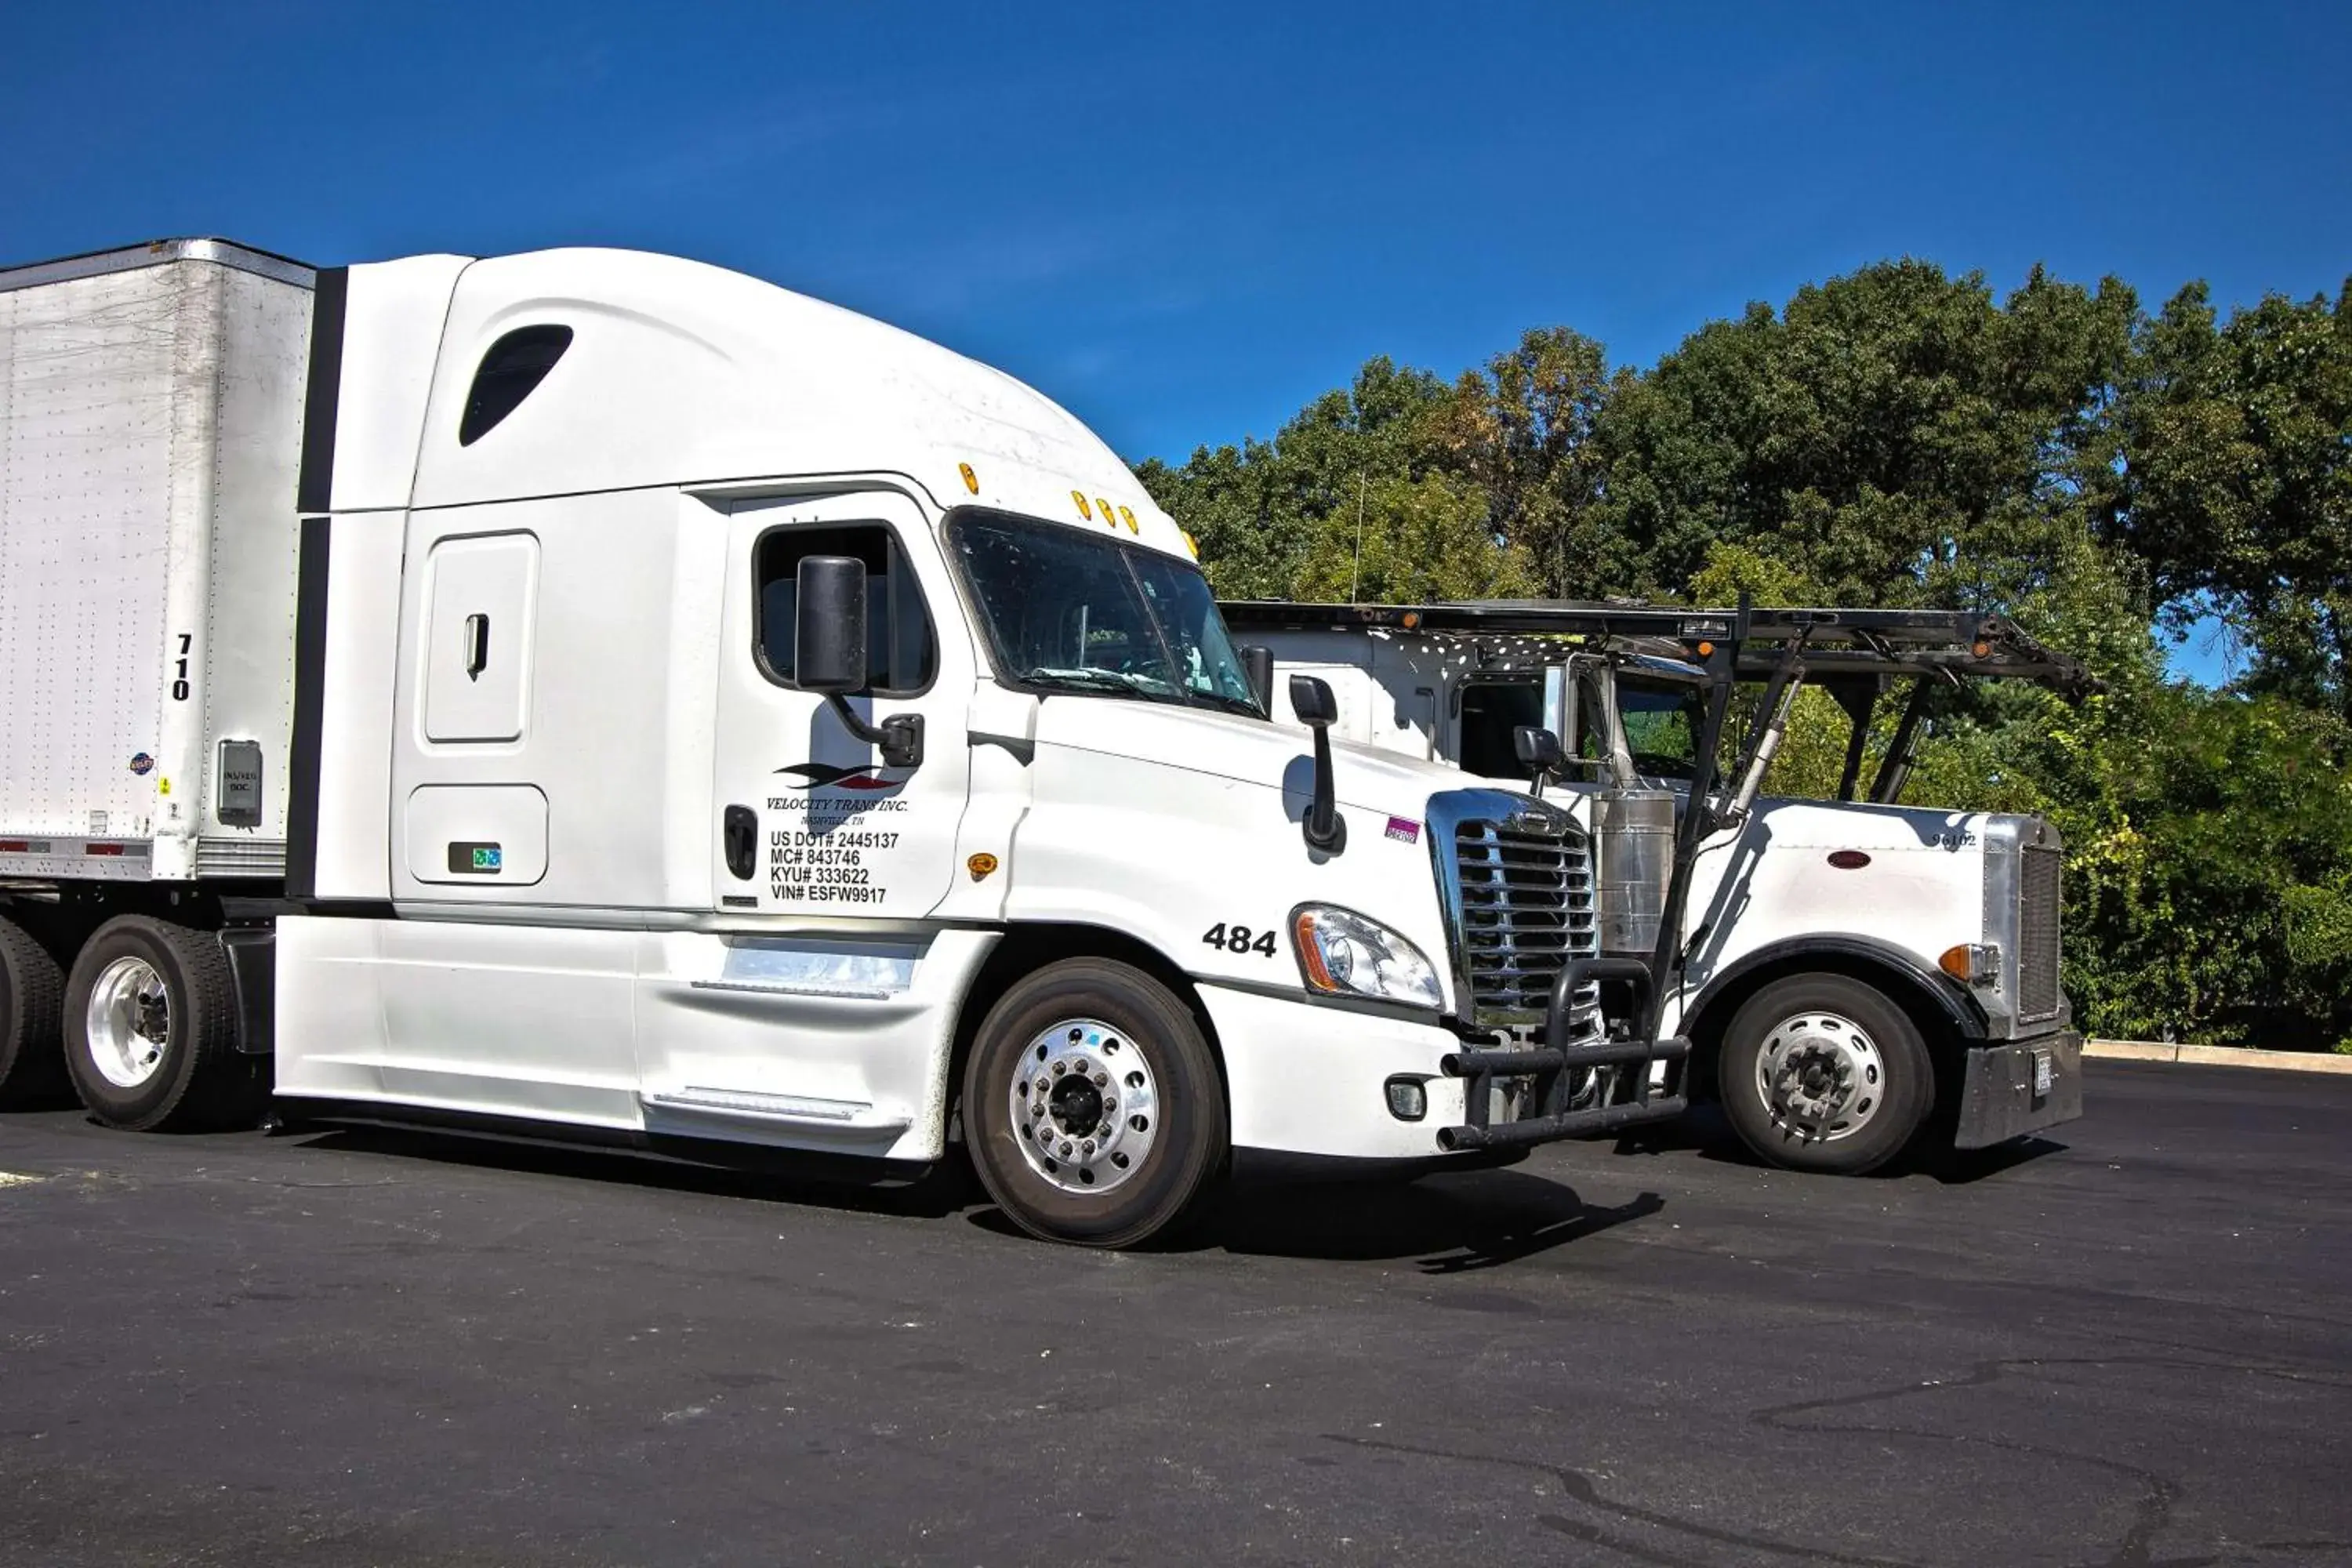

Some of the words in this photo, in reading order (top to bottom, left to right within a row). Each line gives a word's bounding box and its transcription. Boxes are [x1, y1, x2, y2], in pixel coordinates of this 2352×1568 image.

[172, 633, 191, 701] 710
[767, 797, 832, 810] VELOCITY
[833, 799, 877, 811] TRANS
[878, 800, 908, 811] INC.
[771, 831, 790, 846] US
[794, 831, 835, 848] DOT#
[838, 832, 899, 848] 2445137
[771, 848, 803, 864] MC#
[807, 849, 861, 866] 843746
[771, 866, 812, 883] KYU#
[816, 867, 869, 884] 333622
[771, 884, 805, 901] VIN#
[808, 886, 887, 903] ESFW9917
[1202, 922, 1277, 959] 484
